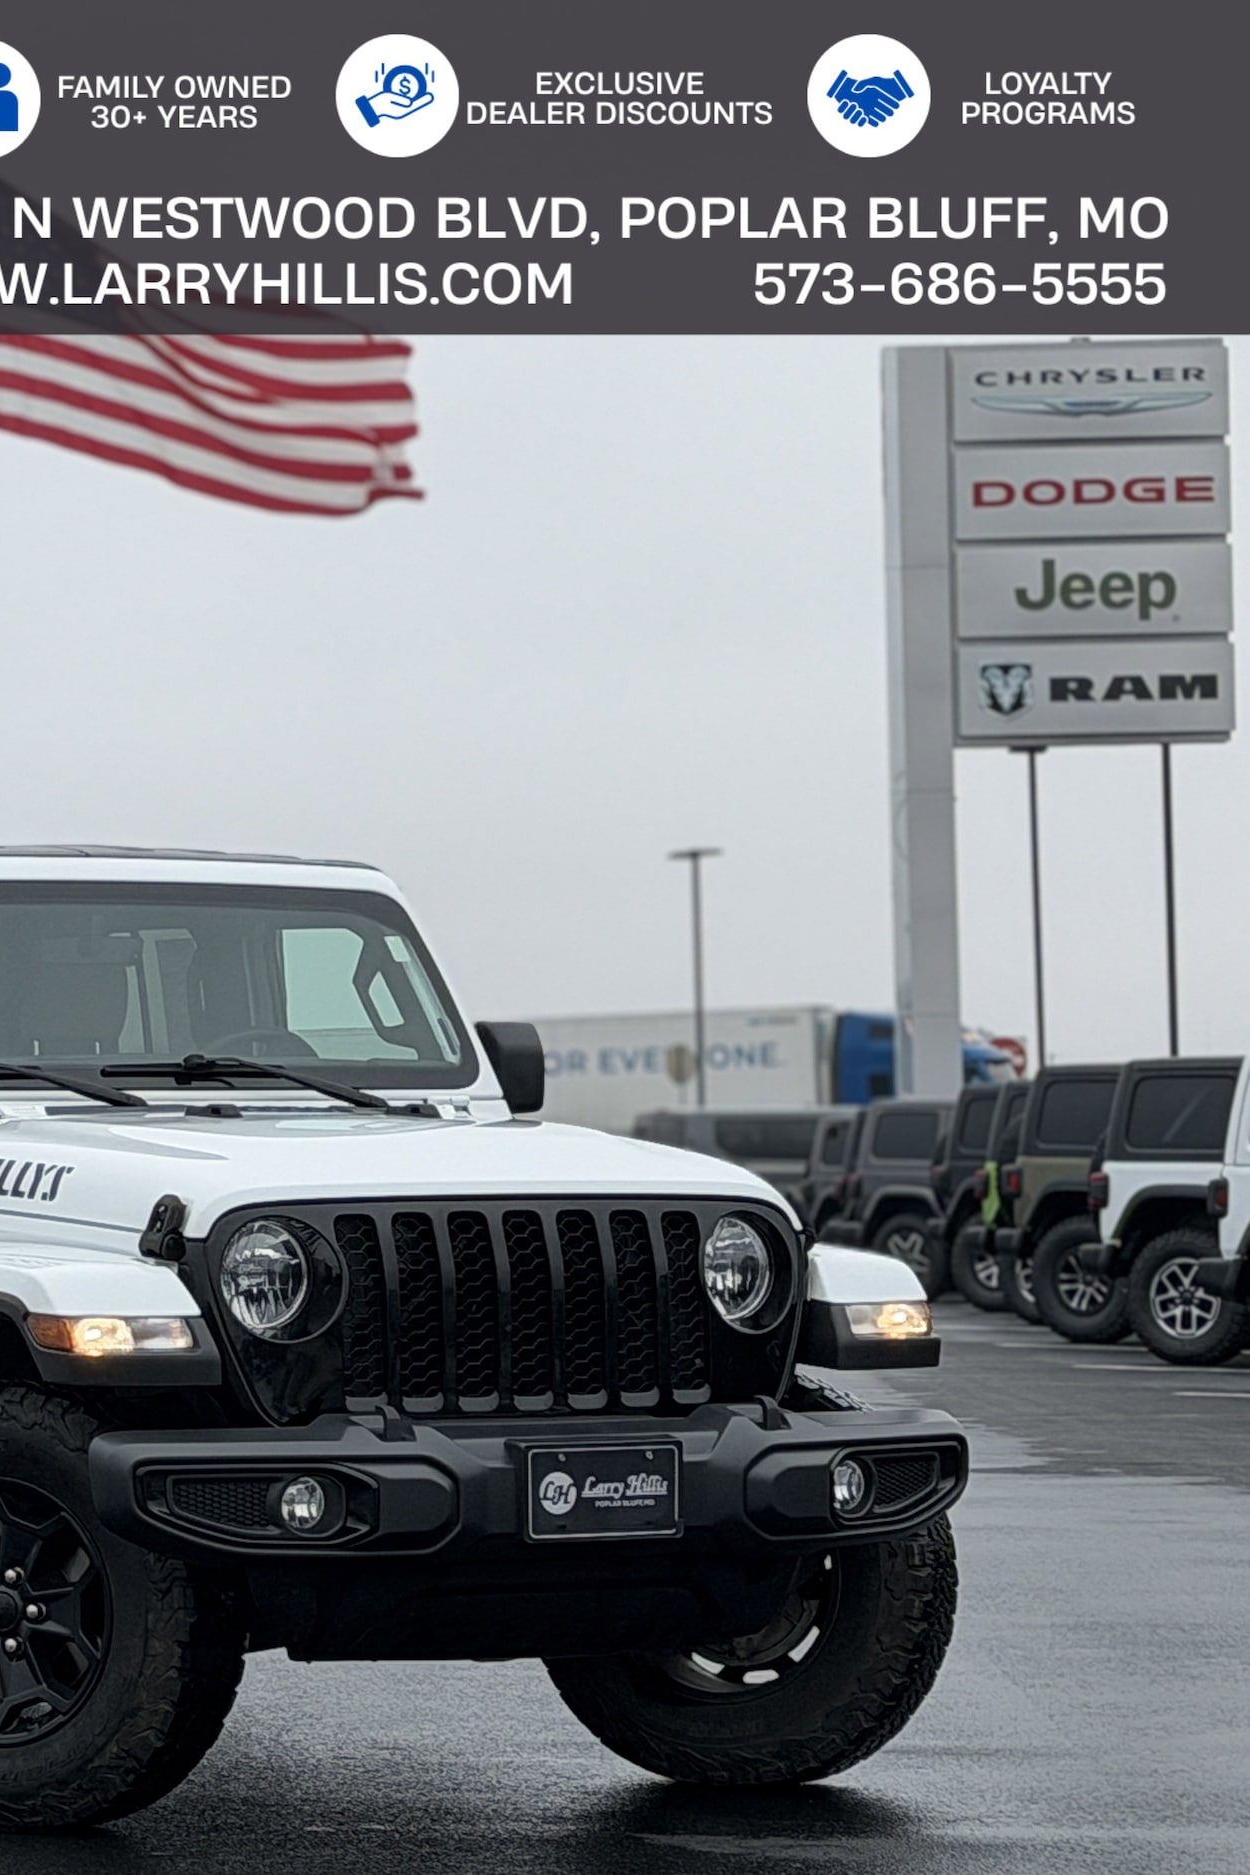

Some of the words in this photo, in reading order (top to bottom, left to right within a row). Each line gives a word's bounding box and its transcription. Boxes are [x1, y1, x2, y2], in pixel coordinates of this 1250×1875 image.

[974, 366, 1207, 388] CHRYSLER
[971, 476, 1215, 508] DODGE
[1014, 558, 1177, 621] Jeep
[1048, 674, 1220, 702] RAM
[597, 1041, 781, 1075] EVEONE
[581, 1476, 625, 1499] Larry
[625, 1473, 668, 1496] Hillis
